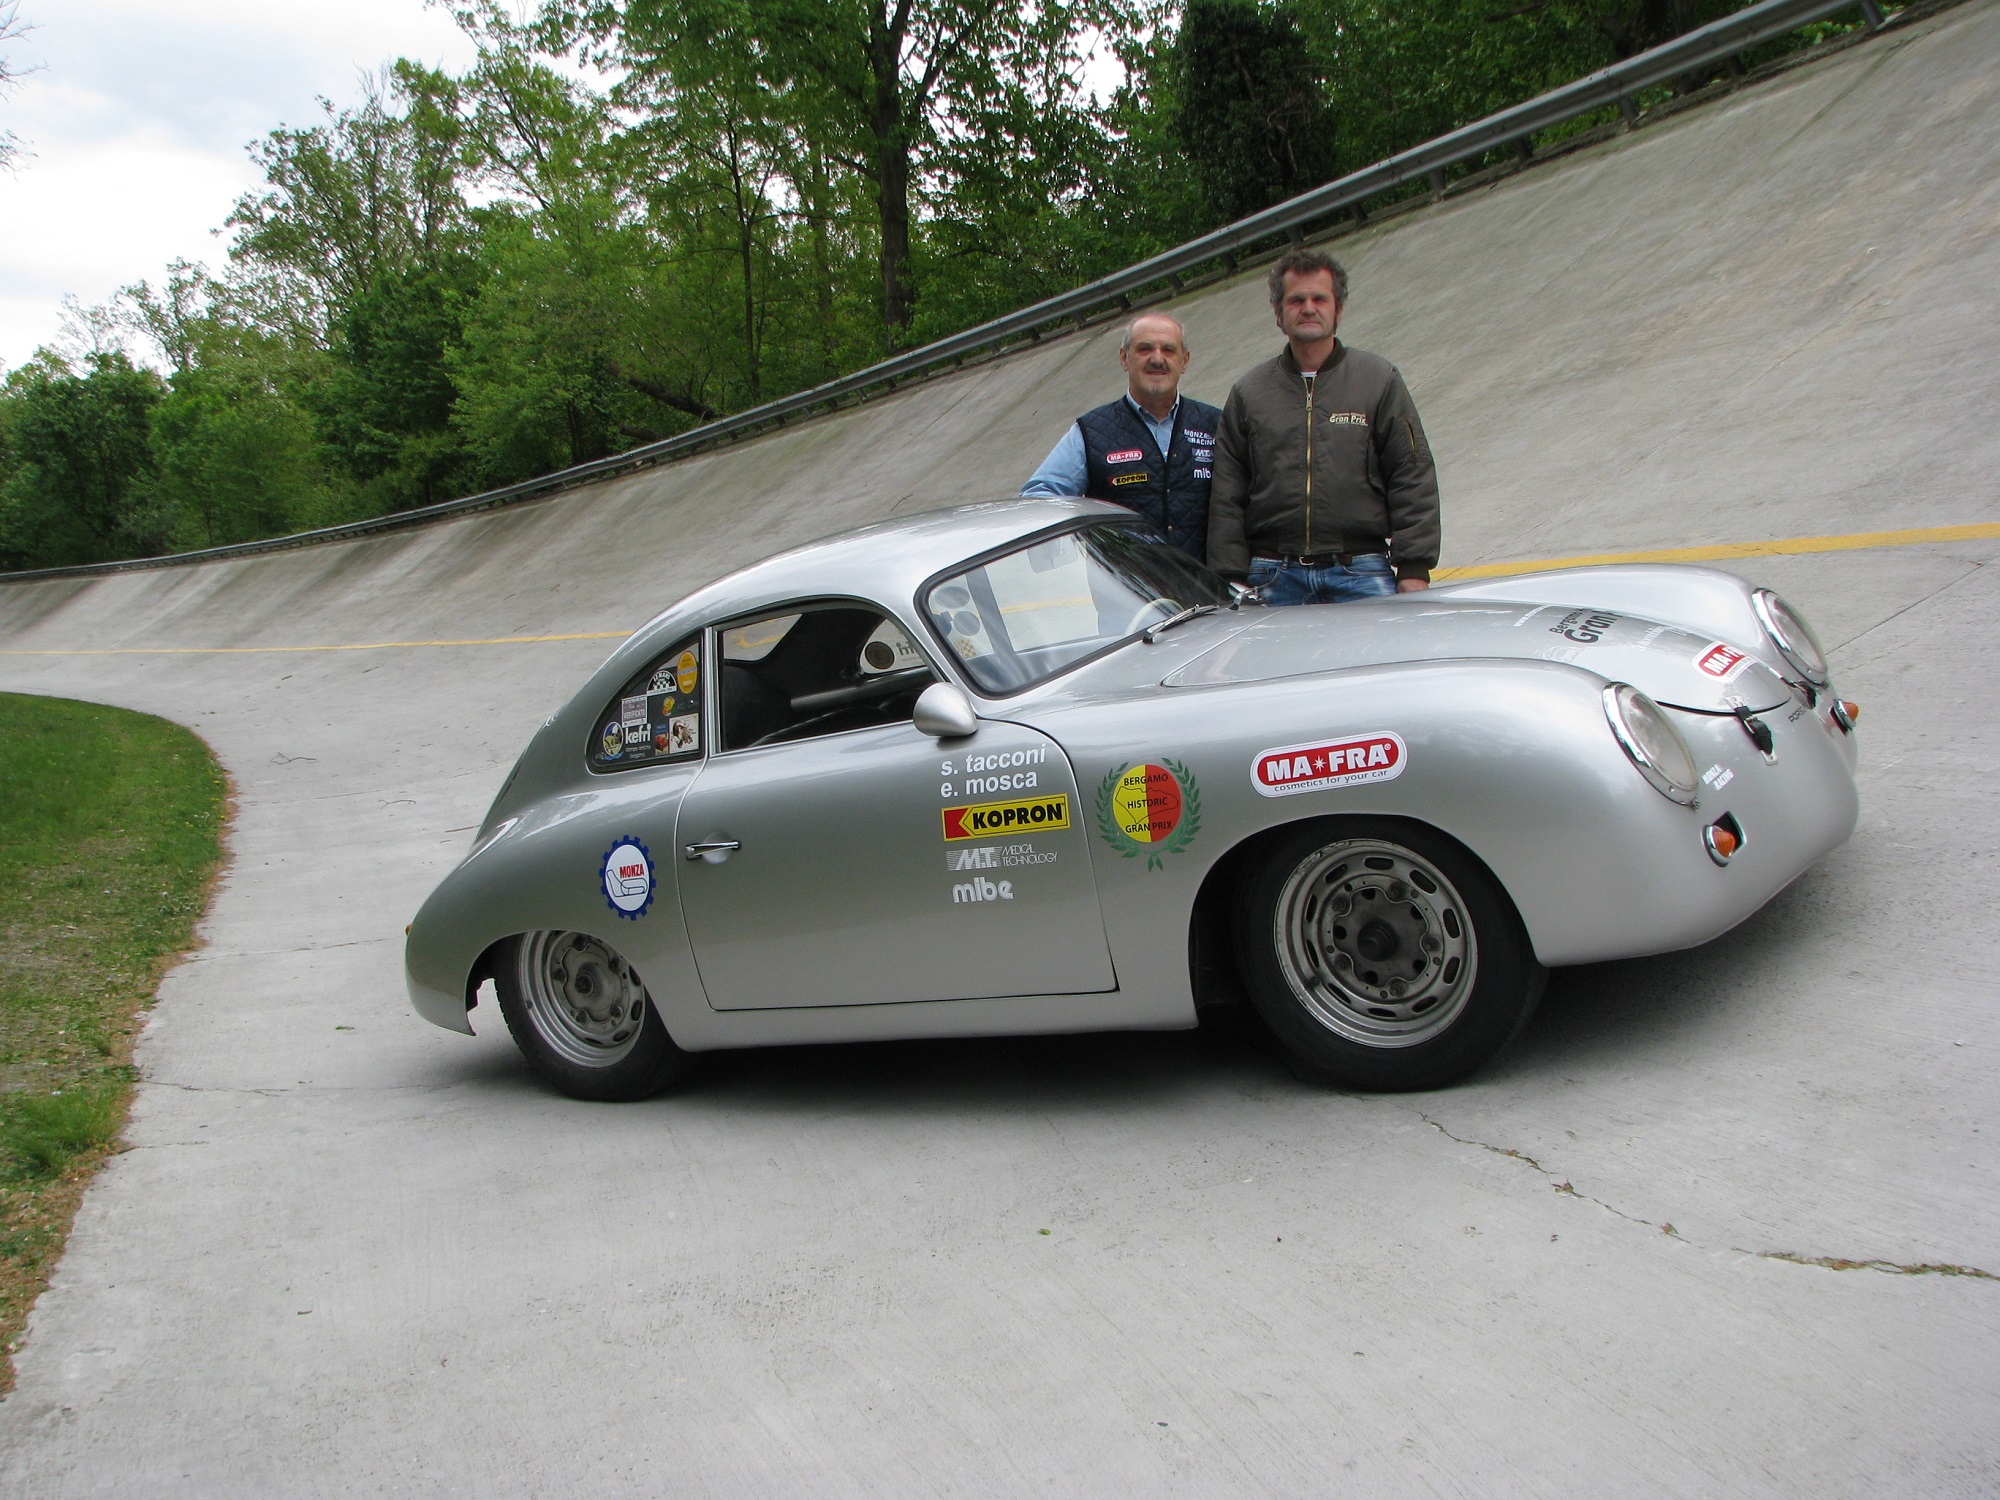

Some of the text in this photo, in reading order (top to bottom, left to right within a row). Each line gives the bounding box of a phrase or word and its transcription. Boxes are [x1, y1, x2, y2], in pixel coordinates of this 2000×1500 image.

[1351, 415, 1367, 425] Prix
[1184, 429, 1208, 439] MONZA
[1116, 474, 1146, 485] KOPRON
[1564, 615, 1618, 644] Gran
[625, 723, 652, 745] kefri
[941, 743, 1047, 776] s. tacconi
[941, 770, 1038, 798] e. mosca
[1123, 773, 1169, 786] BERGAMO
[1274, 770, 1388, 792] cosmetics for your car
[1127, 797, 1168, 809] HISTORIC
[972, 802, 1063, 829] KOPRON
[1125, 821, 1172, 833] GRAN PRIX
[1002, 844, 1034, 855] MEDICAL
[1002, 852, 1059, 867] TECHNOLOGY
[620, 863, 645, 879] MONZA
[952, 876, 1014, 904] mibe
